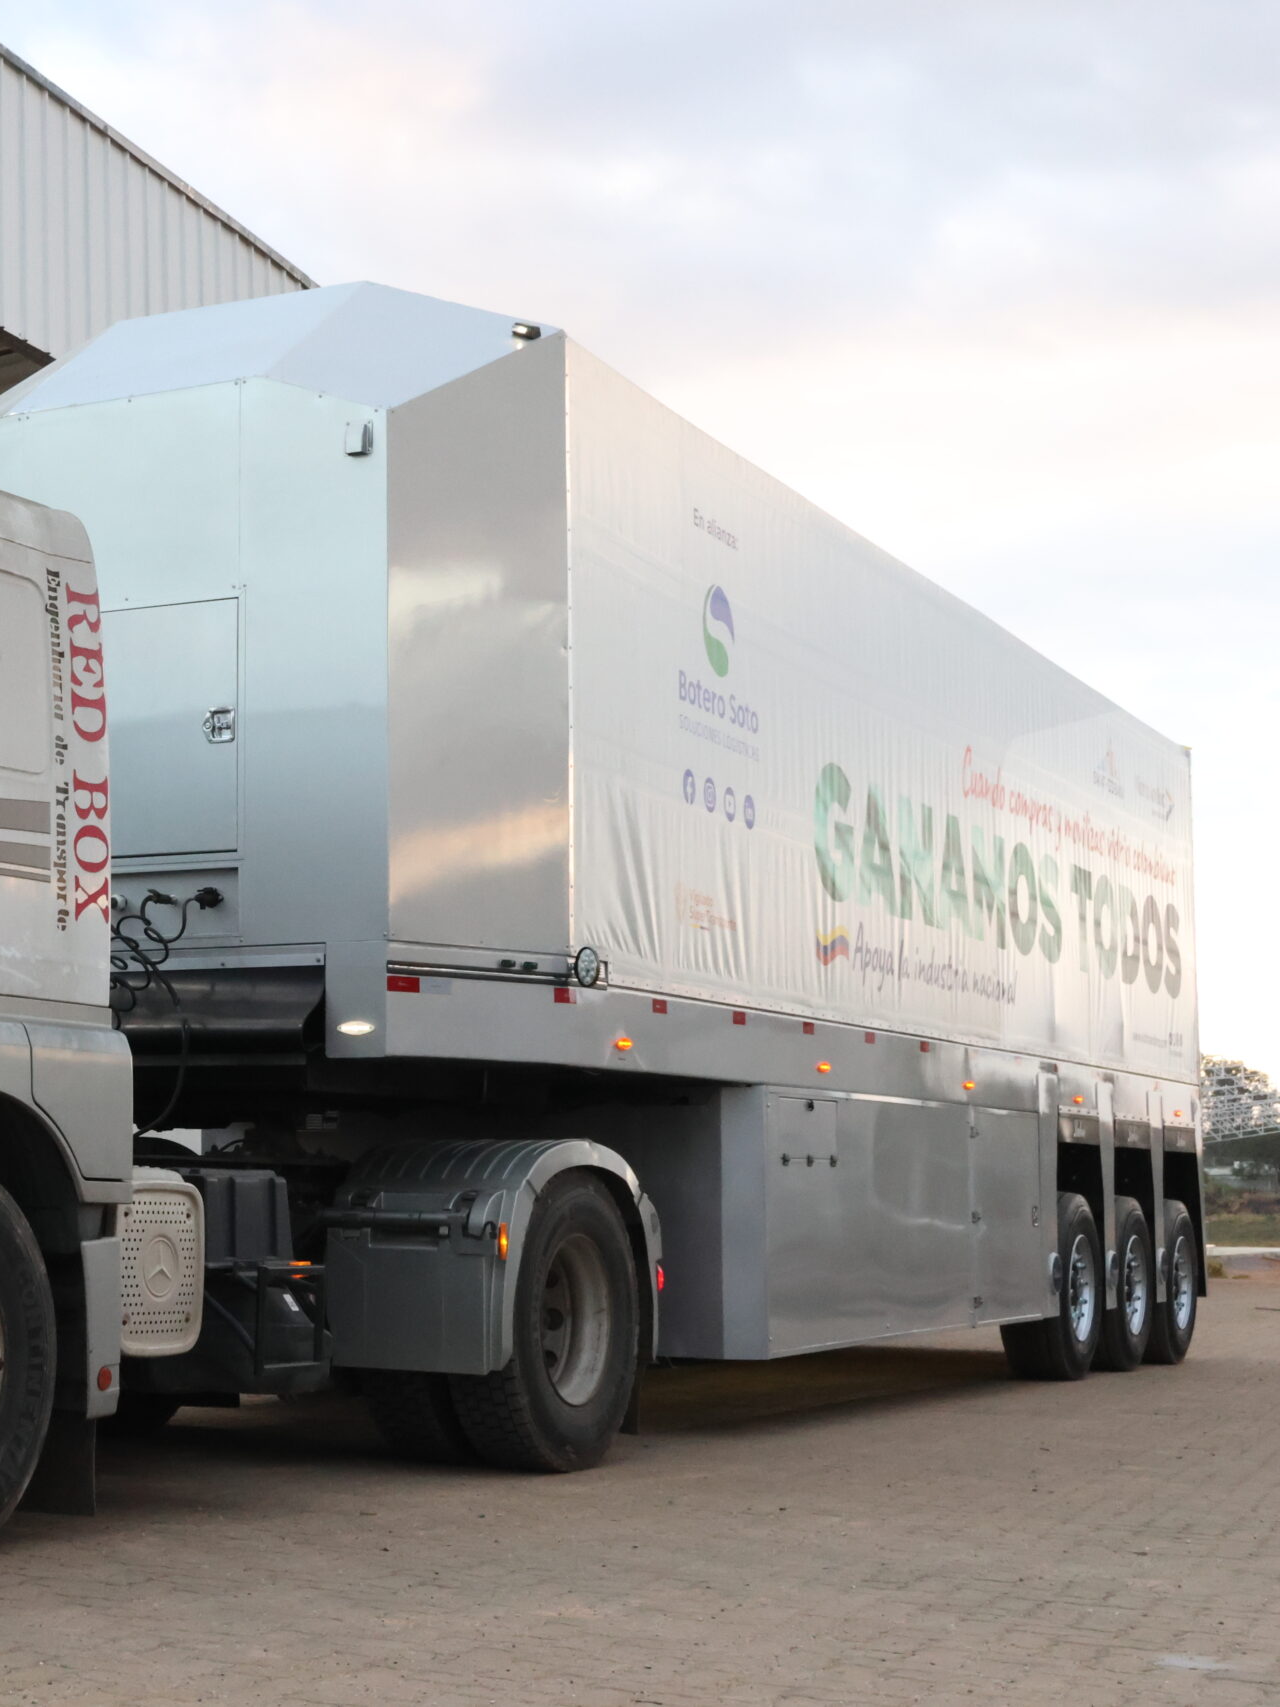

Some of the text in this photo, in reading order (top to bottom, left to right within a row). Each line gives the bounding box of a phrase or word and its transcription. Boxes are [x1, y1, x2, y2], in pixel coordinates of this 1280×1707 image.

[692, 507, 705, 529] En
[678, 669, 759, 734] Botero Soto
[46, 567, 70, 932] Engenharia de Transporte
[65, 582, 109, 924] RED BOX
[961, 745, 1005, 811] Cuando
[1009, 790, 1052, 835] compras
[814, 762, 1182, 999] GANAMOS TODOS
[852, 921, 1018, 1005] Apoya la industria nacional
